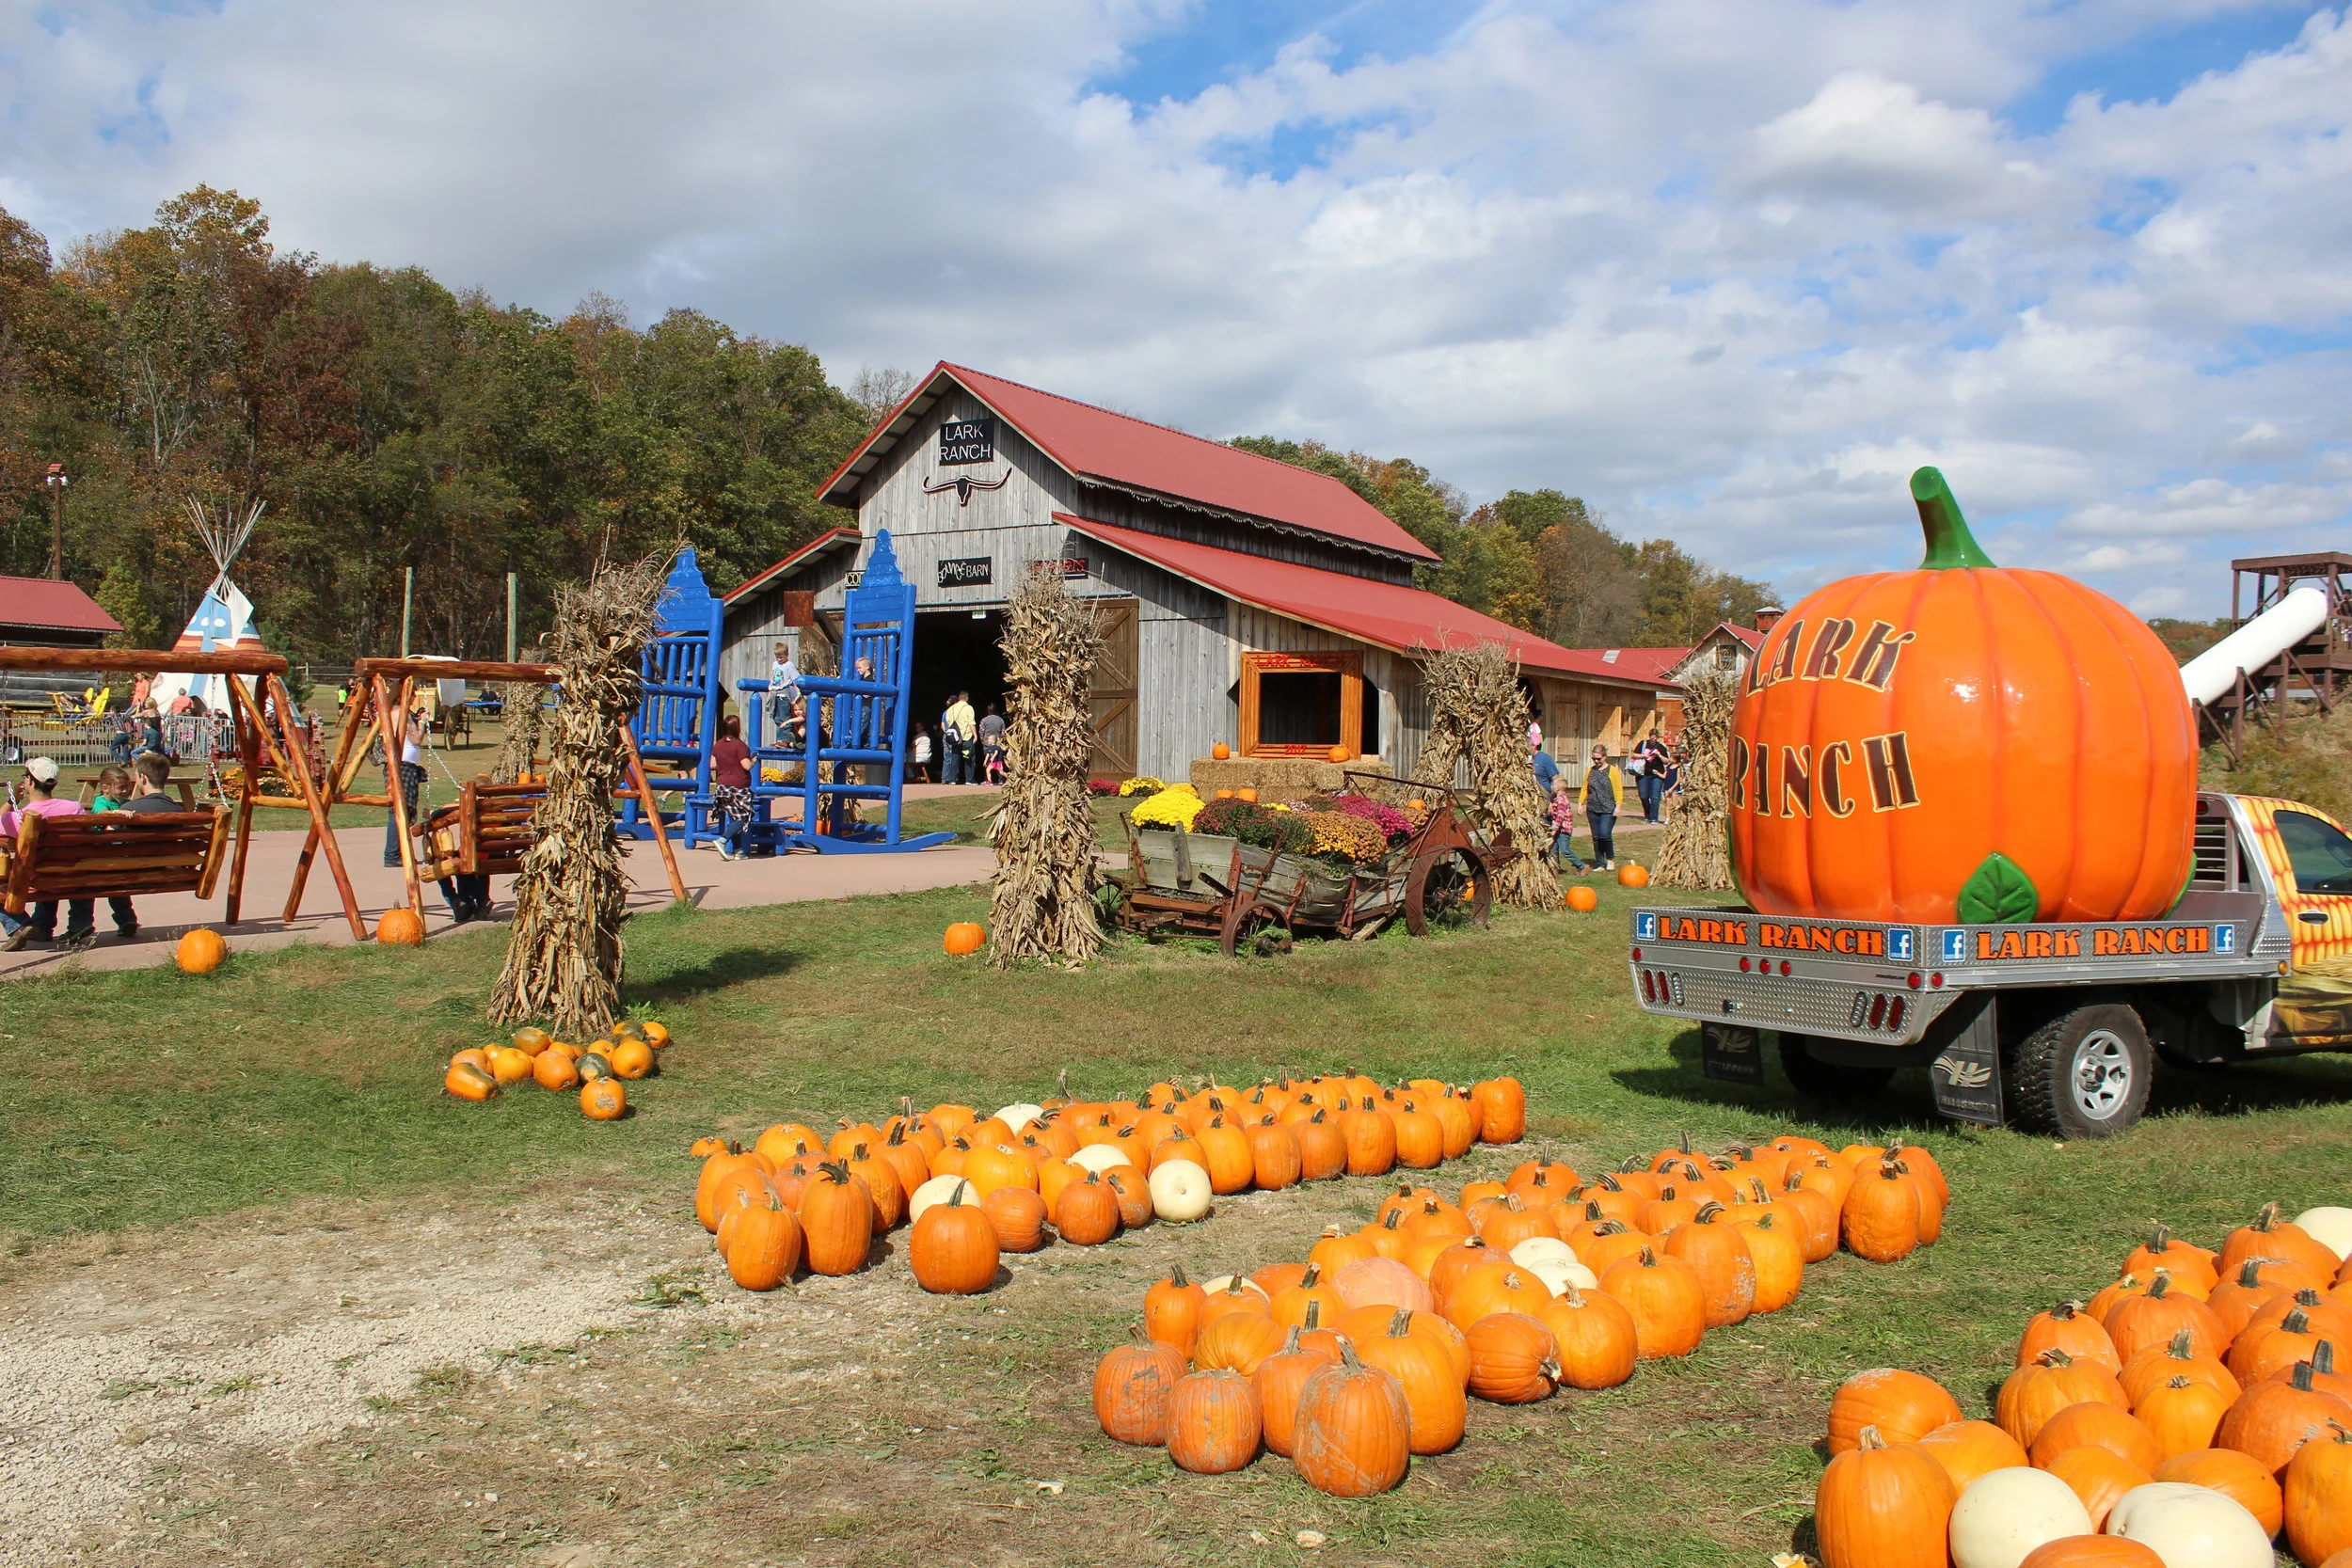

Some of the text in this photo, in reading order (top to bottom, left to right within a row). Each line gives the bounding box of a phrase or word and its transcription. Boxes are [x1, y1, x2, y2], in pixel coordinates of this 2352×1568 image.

[945, 423, 983, 442] LARK
[941, 443, 992, 462] RANCH
[966, 563, 989, 578] BARN
[1746, 617, 1916, 698] LARK
[1731, 730, 1921, 819] RANCH
[1660, 916, 1747, 945] LARK
[1759, 923, 1884, 957] RANCH
[1976, 929, 2081, 959] LARK
[2092, 927, 2210, 957] RANCH
